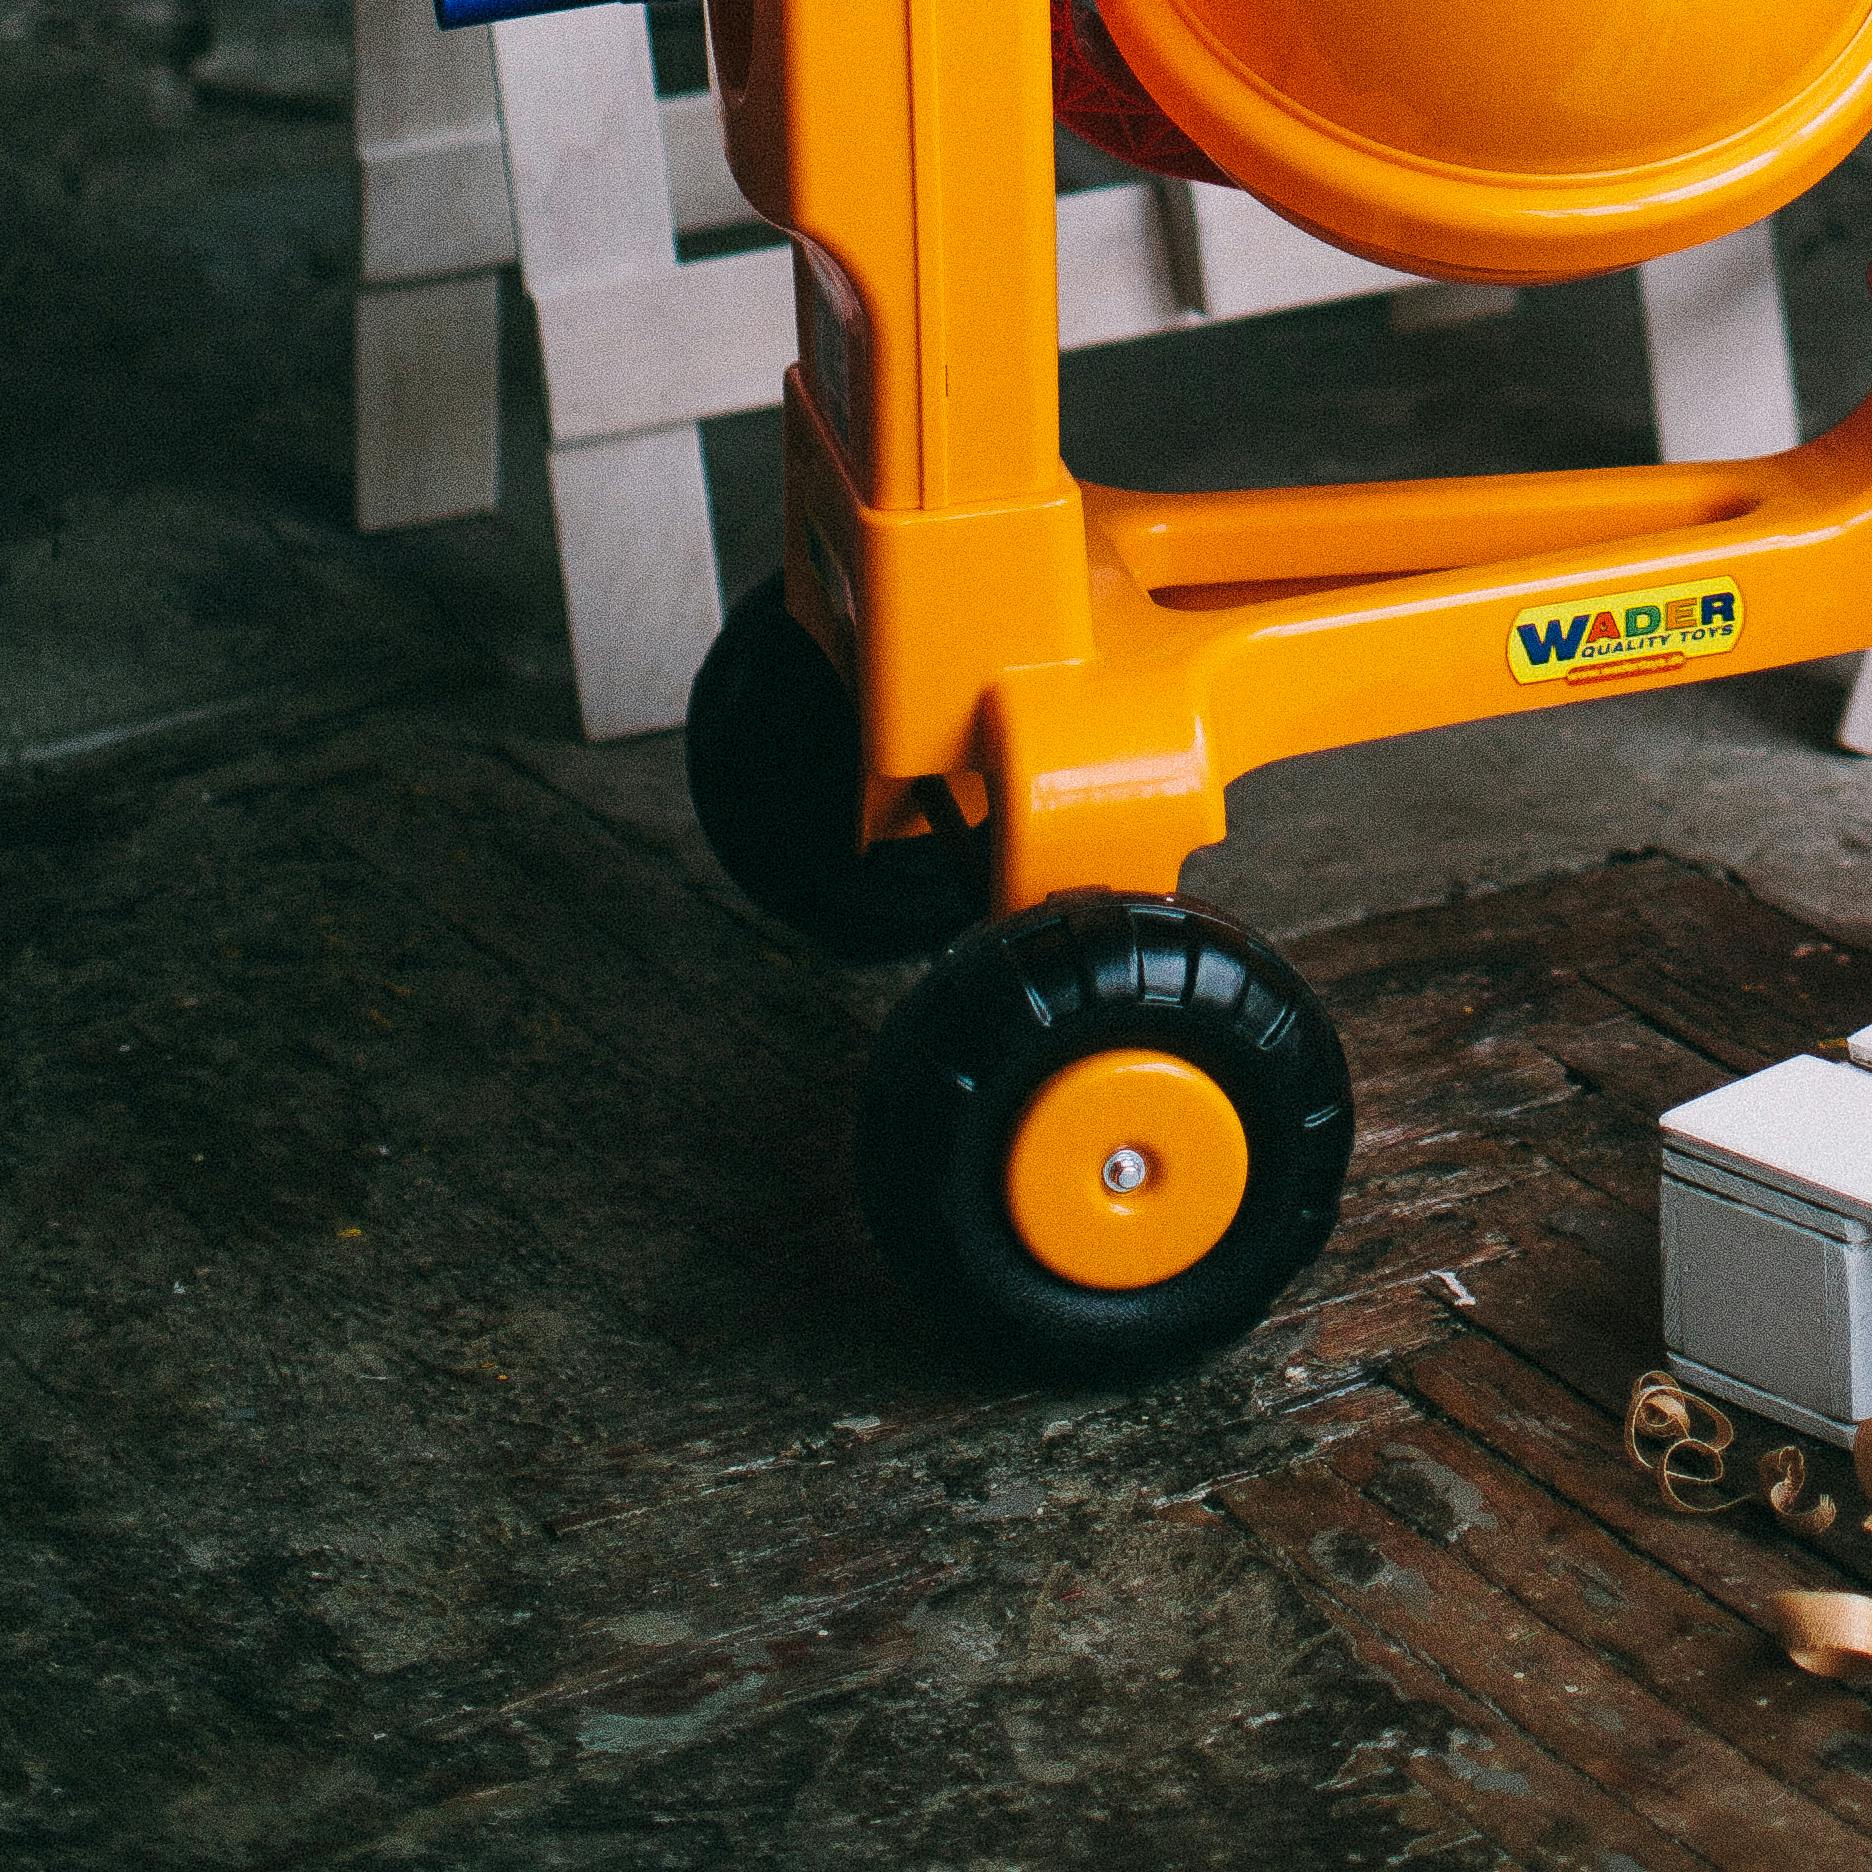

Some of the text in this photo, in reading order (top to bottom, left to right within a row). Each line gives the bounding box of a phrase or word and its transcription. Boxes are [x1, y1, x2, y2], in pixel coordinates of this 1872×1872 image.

[1517, 592, 1735, 665] WADER
[1581, 624, 1734, 658] QUALITY TOYS
